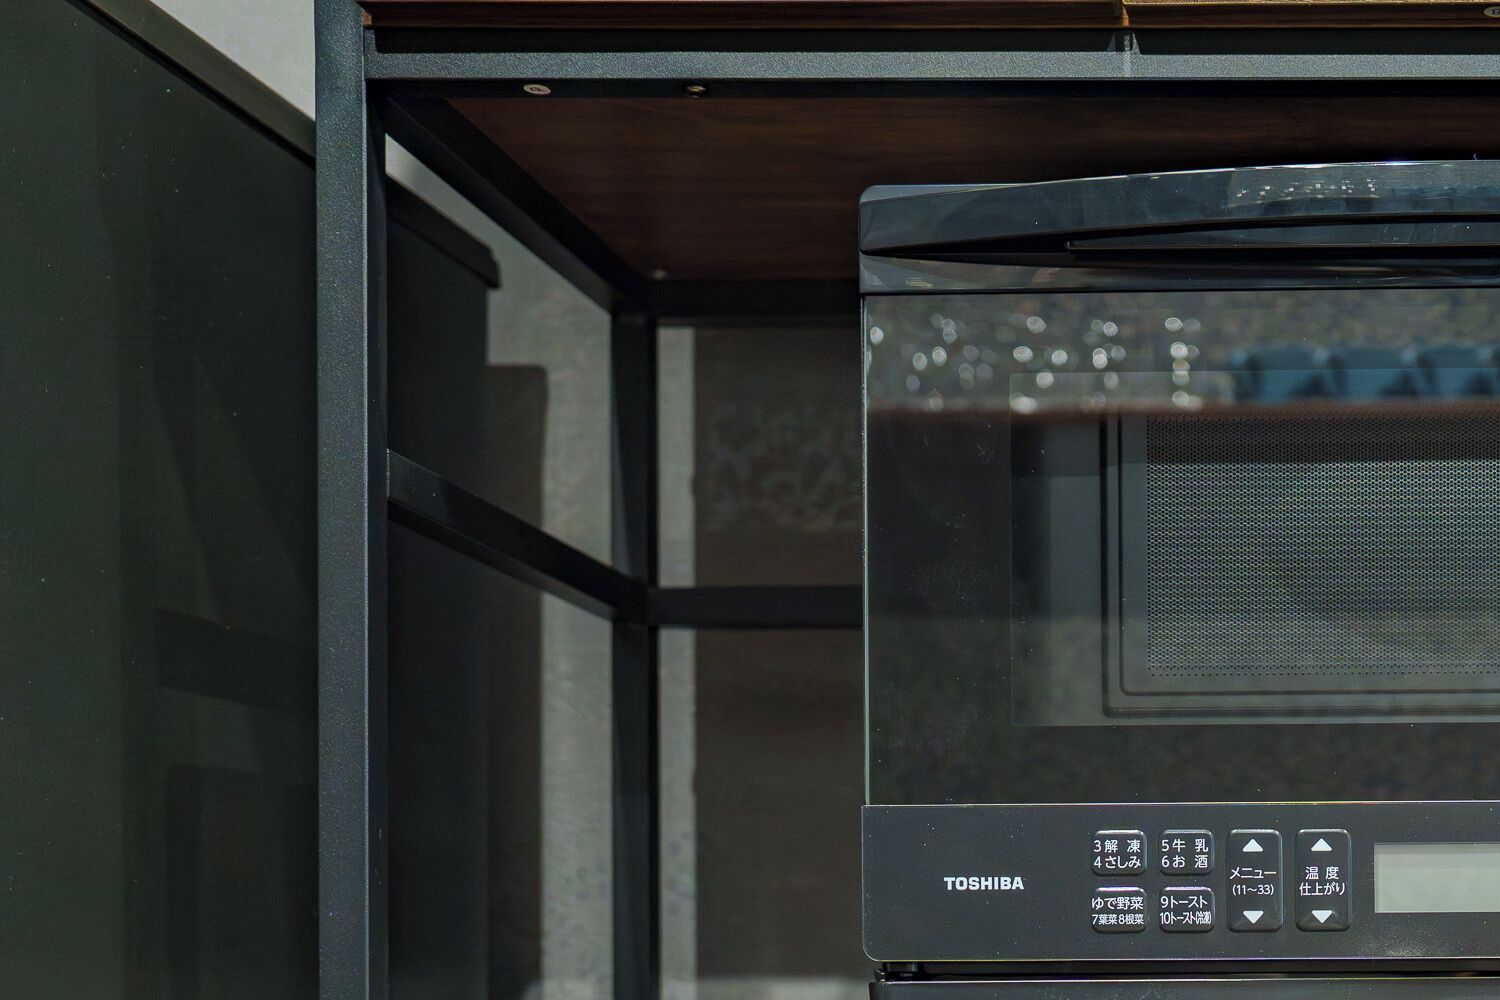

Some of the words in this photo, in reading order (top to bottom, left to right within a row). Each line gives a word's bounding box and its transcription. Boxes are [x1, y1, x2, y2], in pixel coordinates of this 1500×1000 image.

[1229, 866, 1277, 880] メニュー
[943, 876, 1025, 891] TOSHIBA
[1299, 881, 1346, 896] 仕上がり
[1091, 896, 1144, 910] ゆで野菜
[1160, 895, 1208, 909] 9トースト
